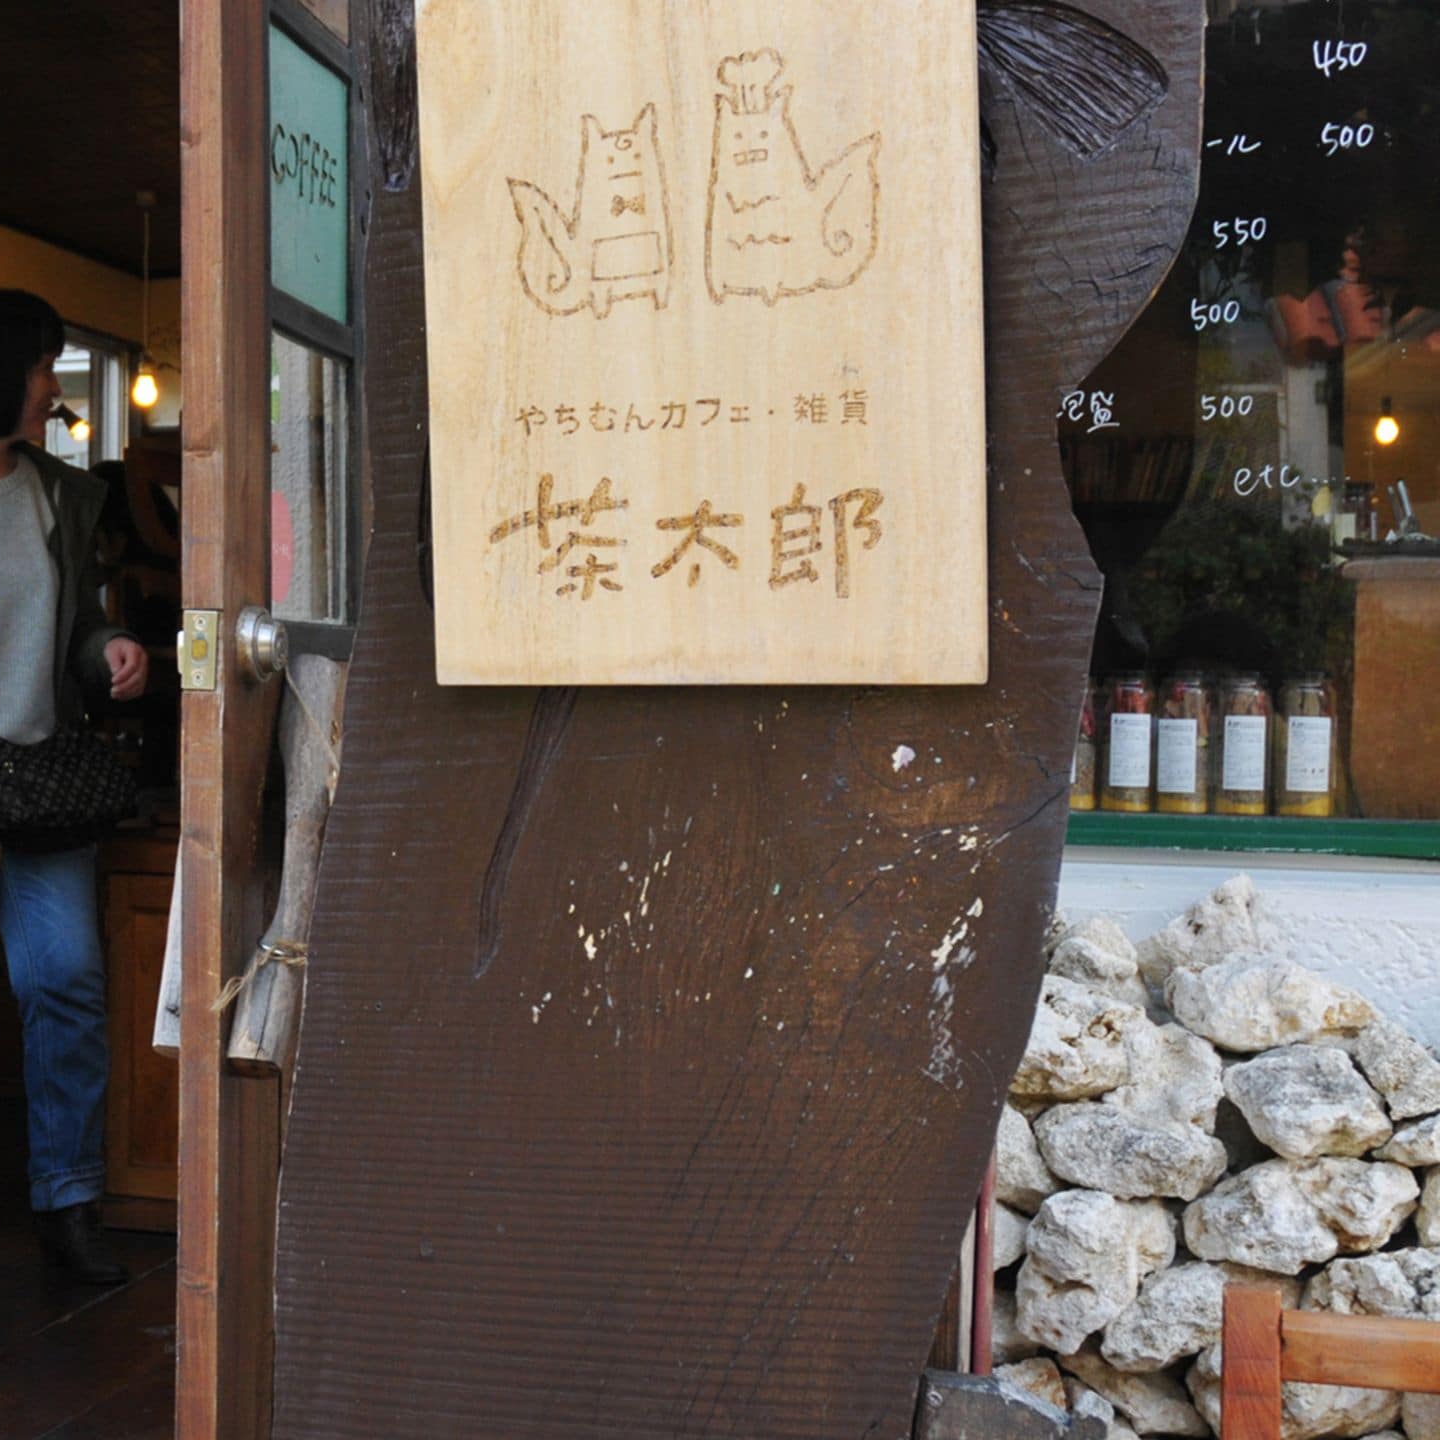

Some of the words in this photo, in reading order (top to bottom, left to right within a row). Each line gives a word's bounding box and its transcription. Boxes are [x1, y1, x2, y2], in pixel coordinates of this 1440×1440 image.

[1311, 38, 1367, 77] 450
[1320, 122, 1375, 157] 500
[1212, 216, 1268, 249] 550
[1190, 298, 1241, 331] 500
[514, 388, 870, 437] やちむんカフェ・雑貨
[1200, 394, 1254, 421] 500
[488, 472, 885, 600] 茶太郎
